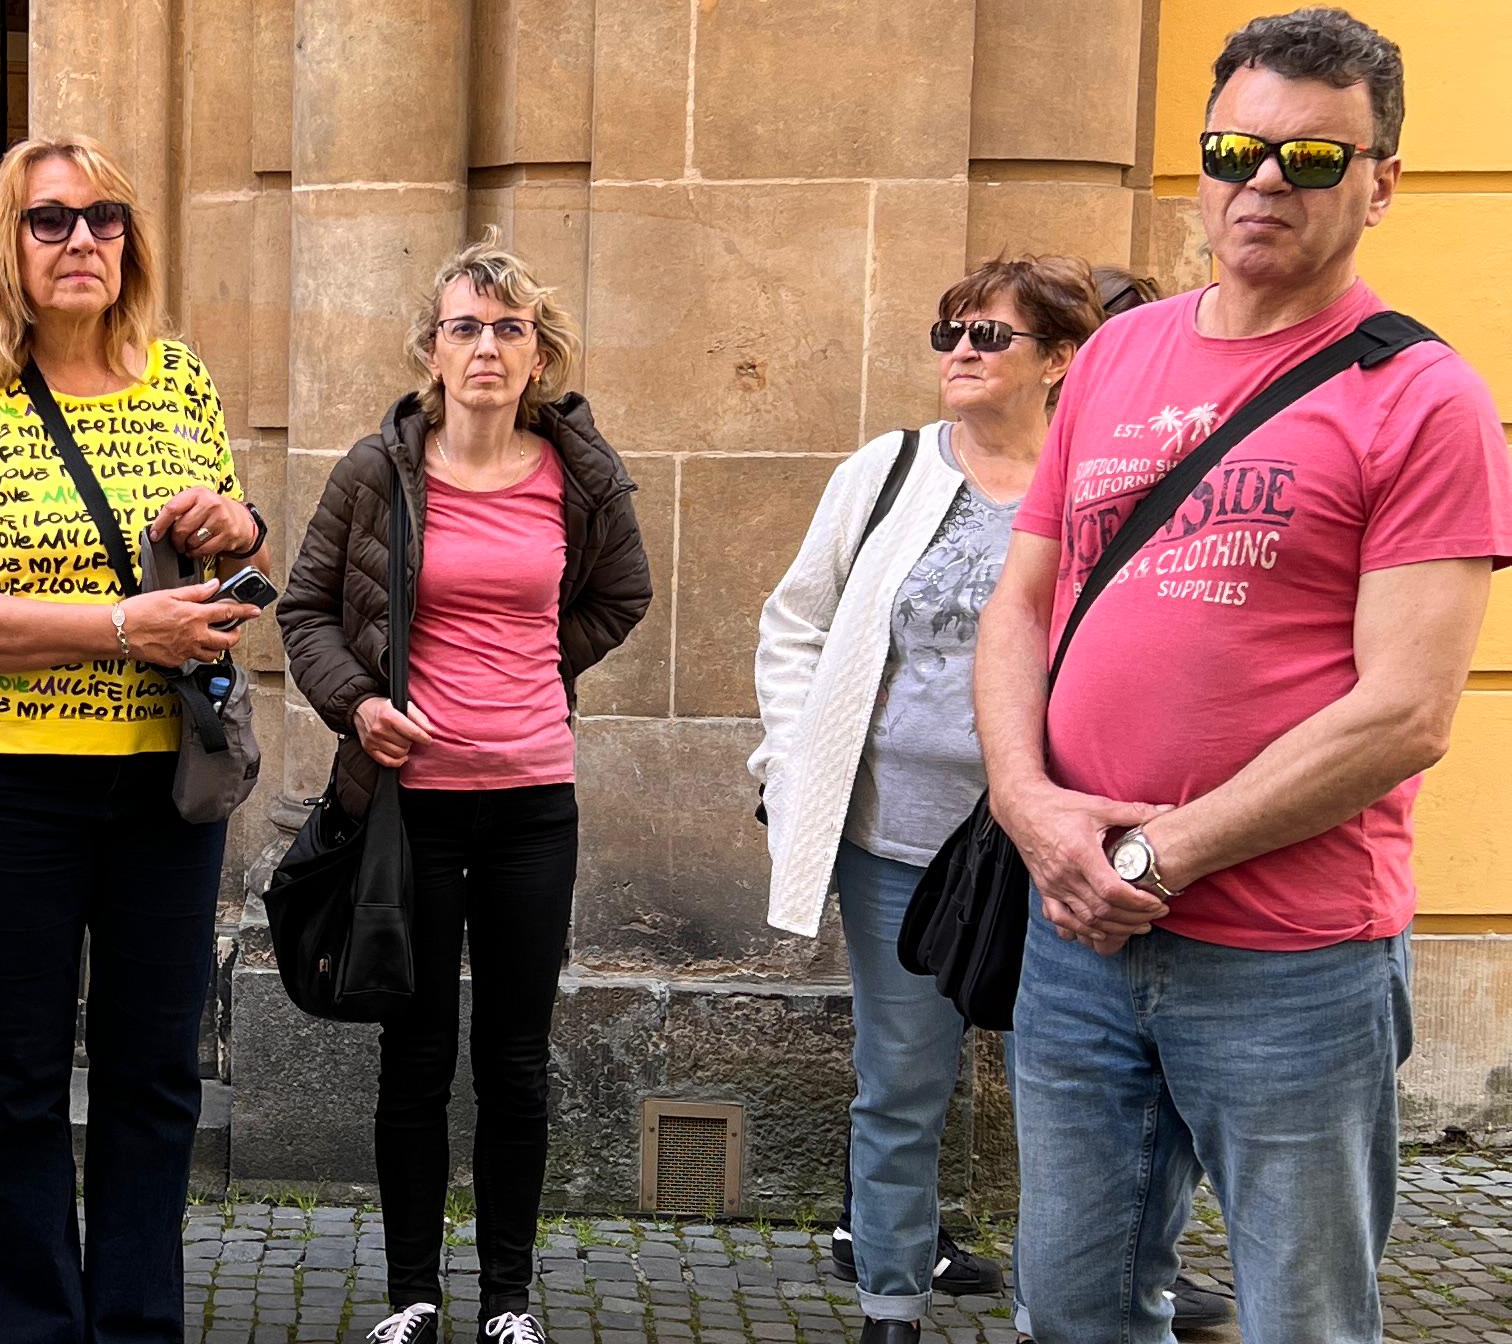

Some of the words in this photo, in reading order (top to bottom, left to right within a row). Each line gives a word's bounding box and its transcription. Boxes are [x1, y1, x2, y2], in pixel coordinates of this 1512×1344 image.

[1113, 423, 1145, 438] EST.
[1155, 459, 1178, 472] SH
[1074, 473, 1167, 503] CALIFORNIA
[1155, 530, 1280, 577] CLOTHING
[1157, 579, 1249, 606] SUPPLIES
